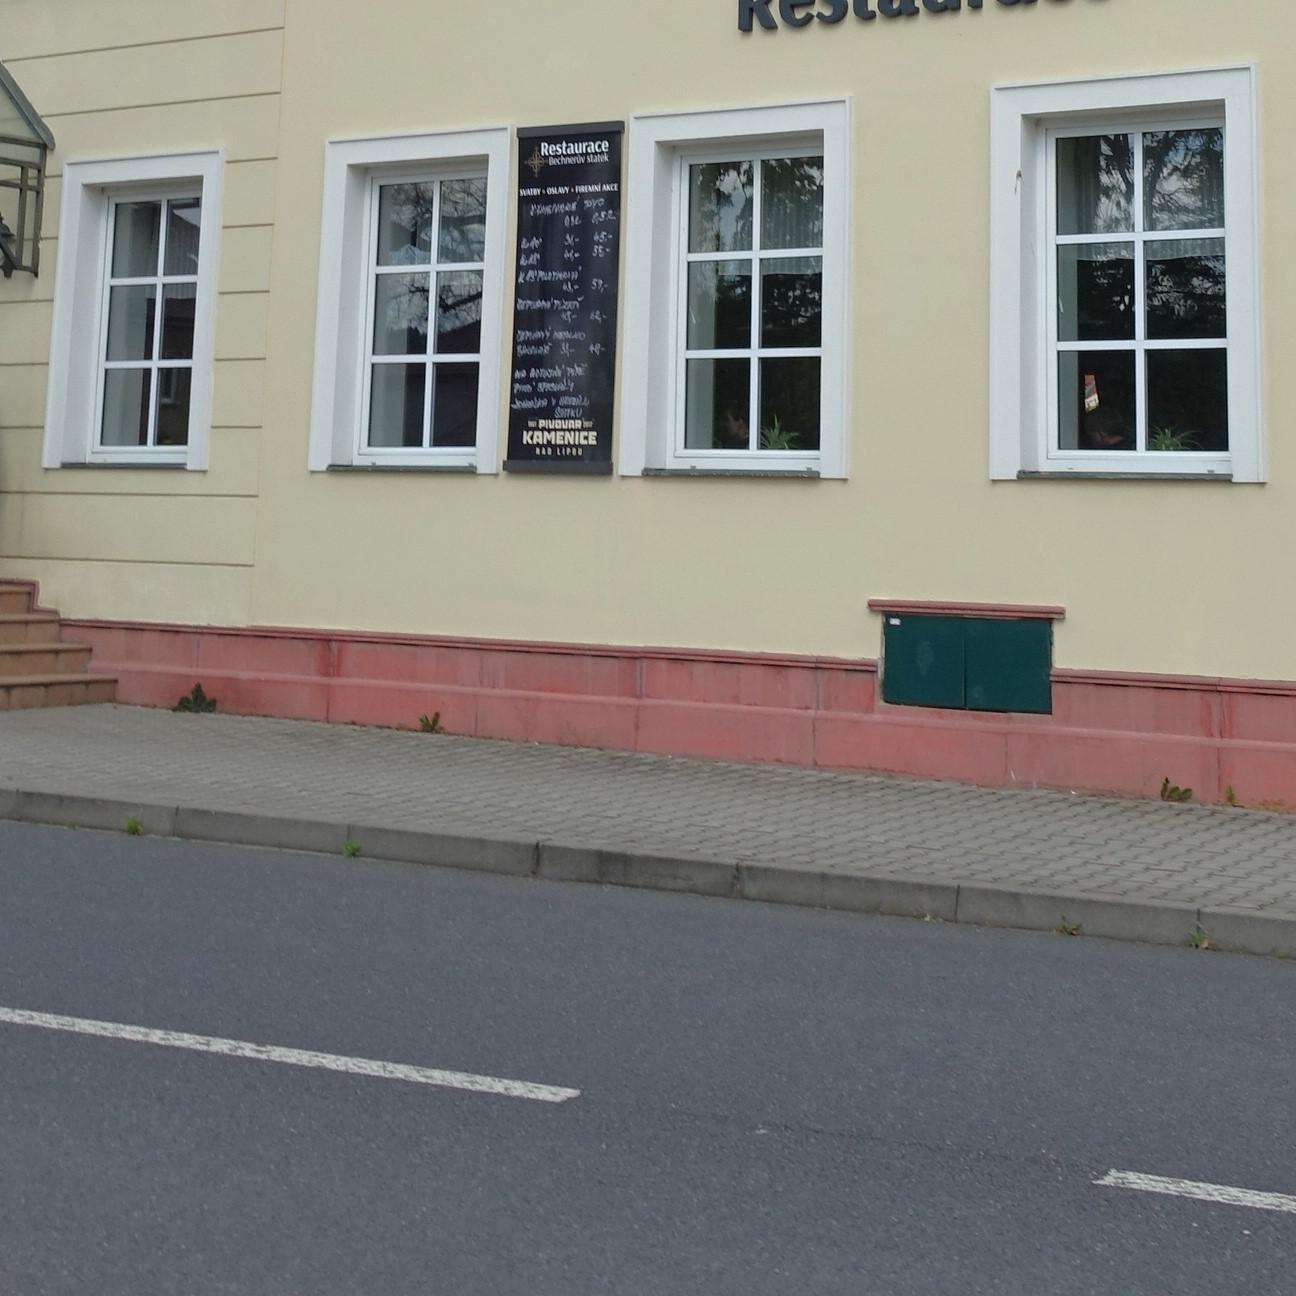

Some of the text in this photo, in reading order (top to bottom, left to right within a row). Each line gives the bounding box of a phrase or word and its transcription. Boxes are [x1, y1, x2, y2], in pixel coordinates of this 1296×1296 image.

[540, 139, 609, 157] Restaurace
[548, 153, 609, 166] Bechnerův statek
[520, 187, 542, 196] SVATBY
[546, 185, 570, 195] OSLAVY
[601, 182, 619, 192] AKCE
[538, 419, 582, 430] PIVOVAR
[522, 431, 598, 446] KAMENICE
